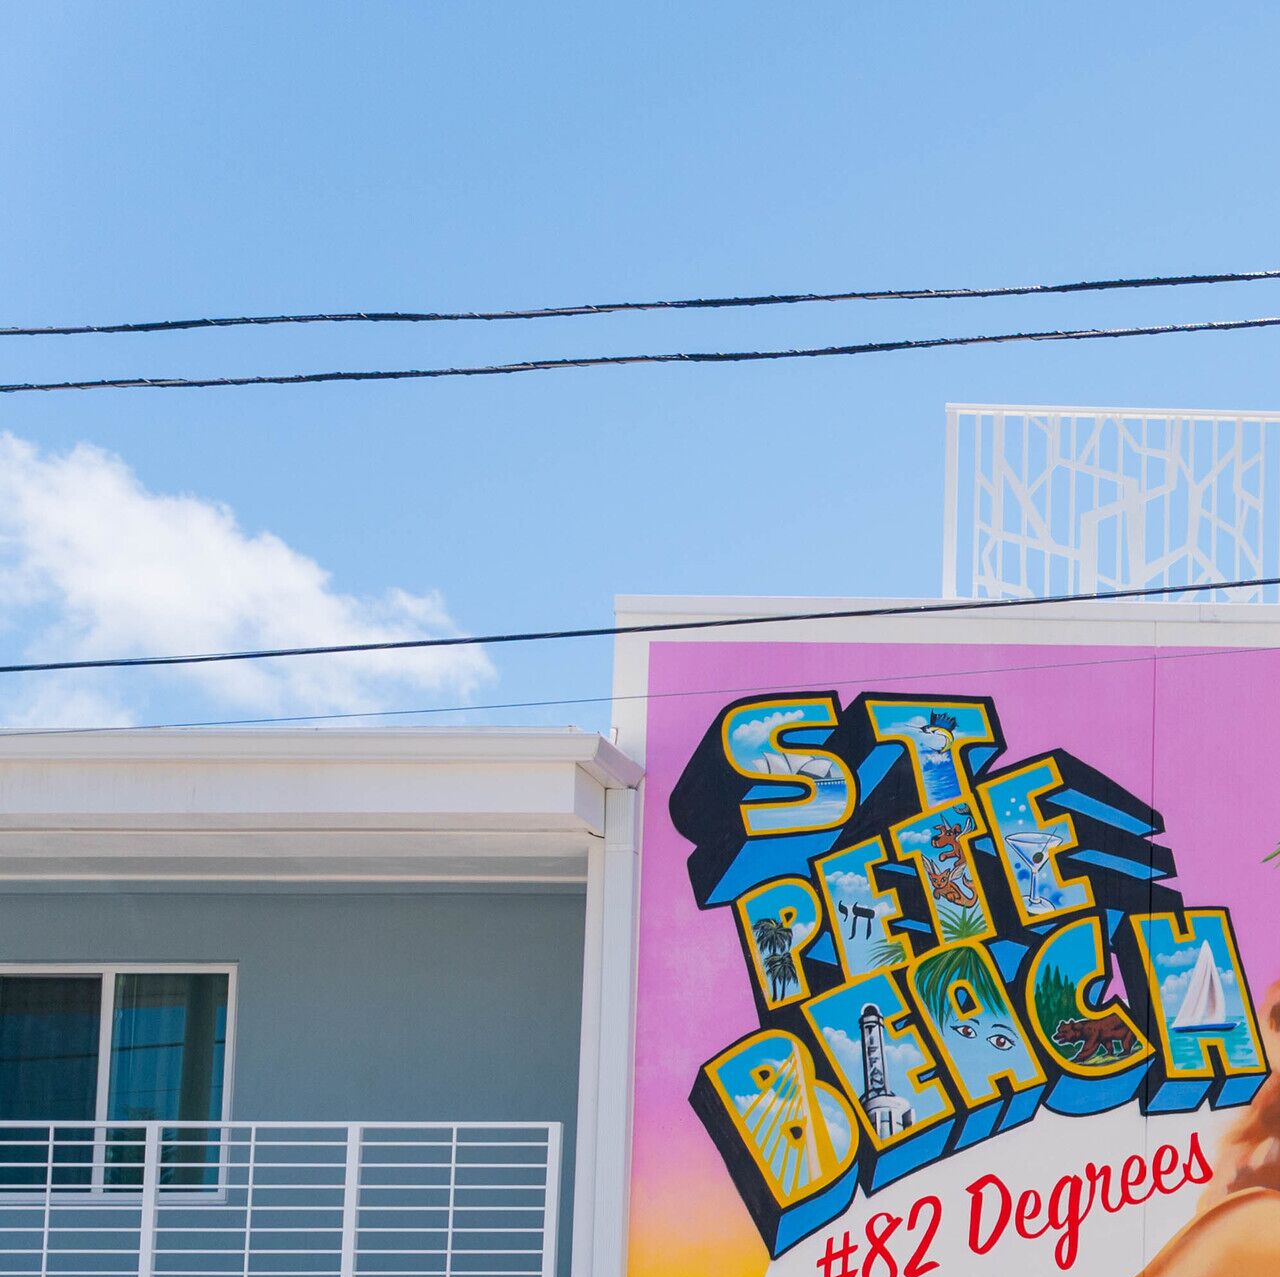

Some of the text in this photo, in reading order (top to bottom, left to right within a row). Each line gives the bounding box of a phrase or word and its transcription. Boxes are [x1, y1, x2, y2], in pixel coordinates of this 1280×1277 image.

[720, 696, 993, 838] ST
[735, 756, 1097, 1011] PETE
[703, 905, 1268, 1210] BEACH
[966, 1131, 1214, 1271] Degrees
